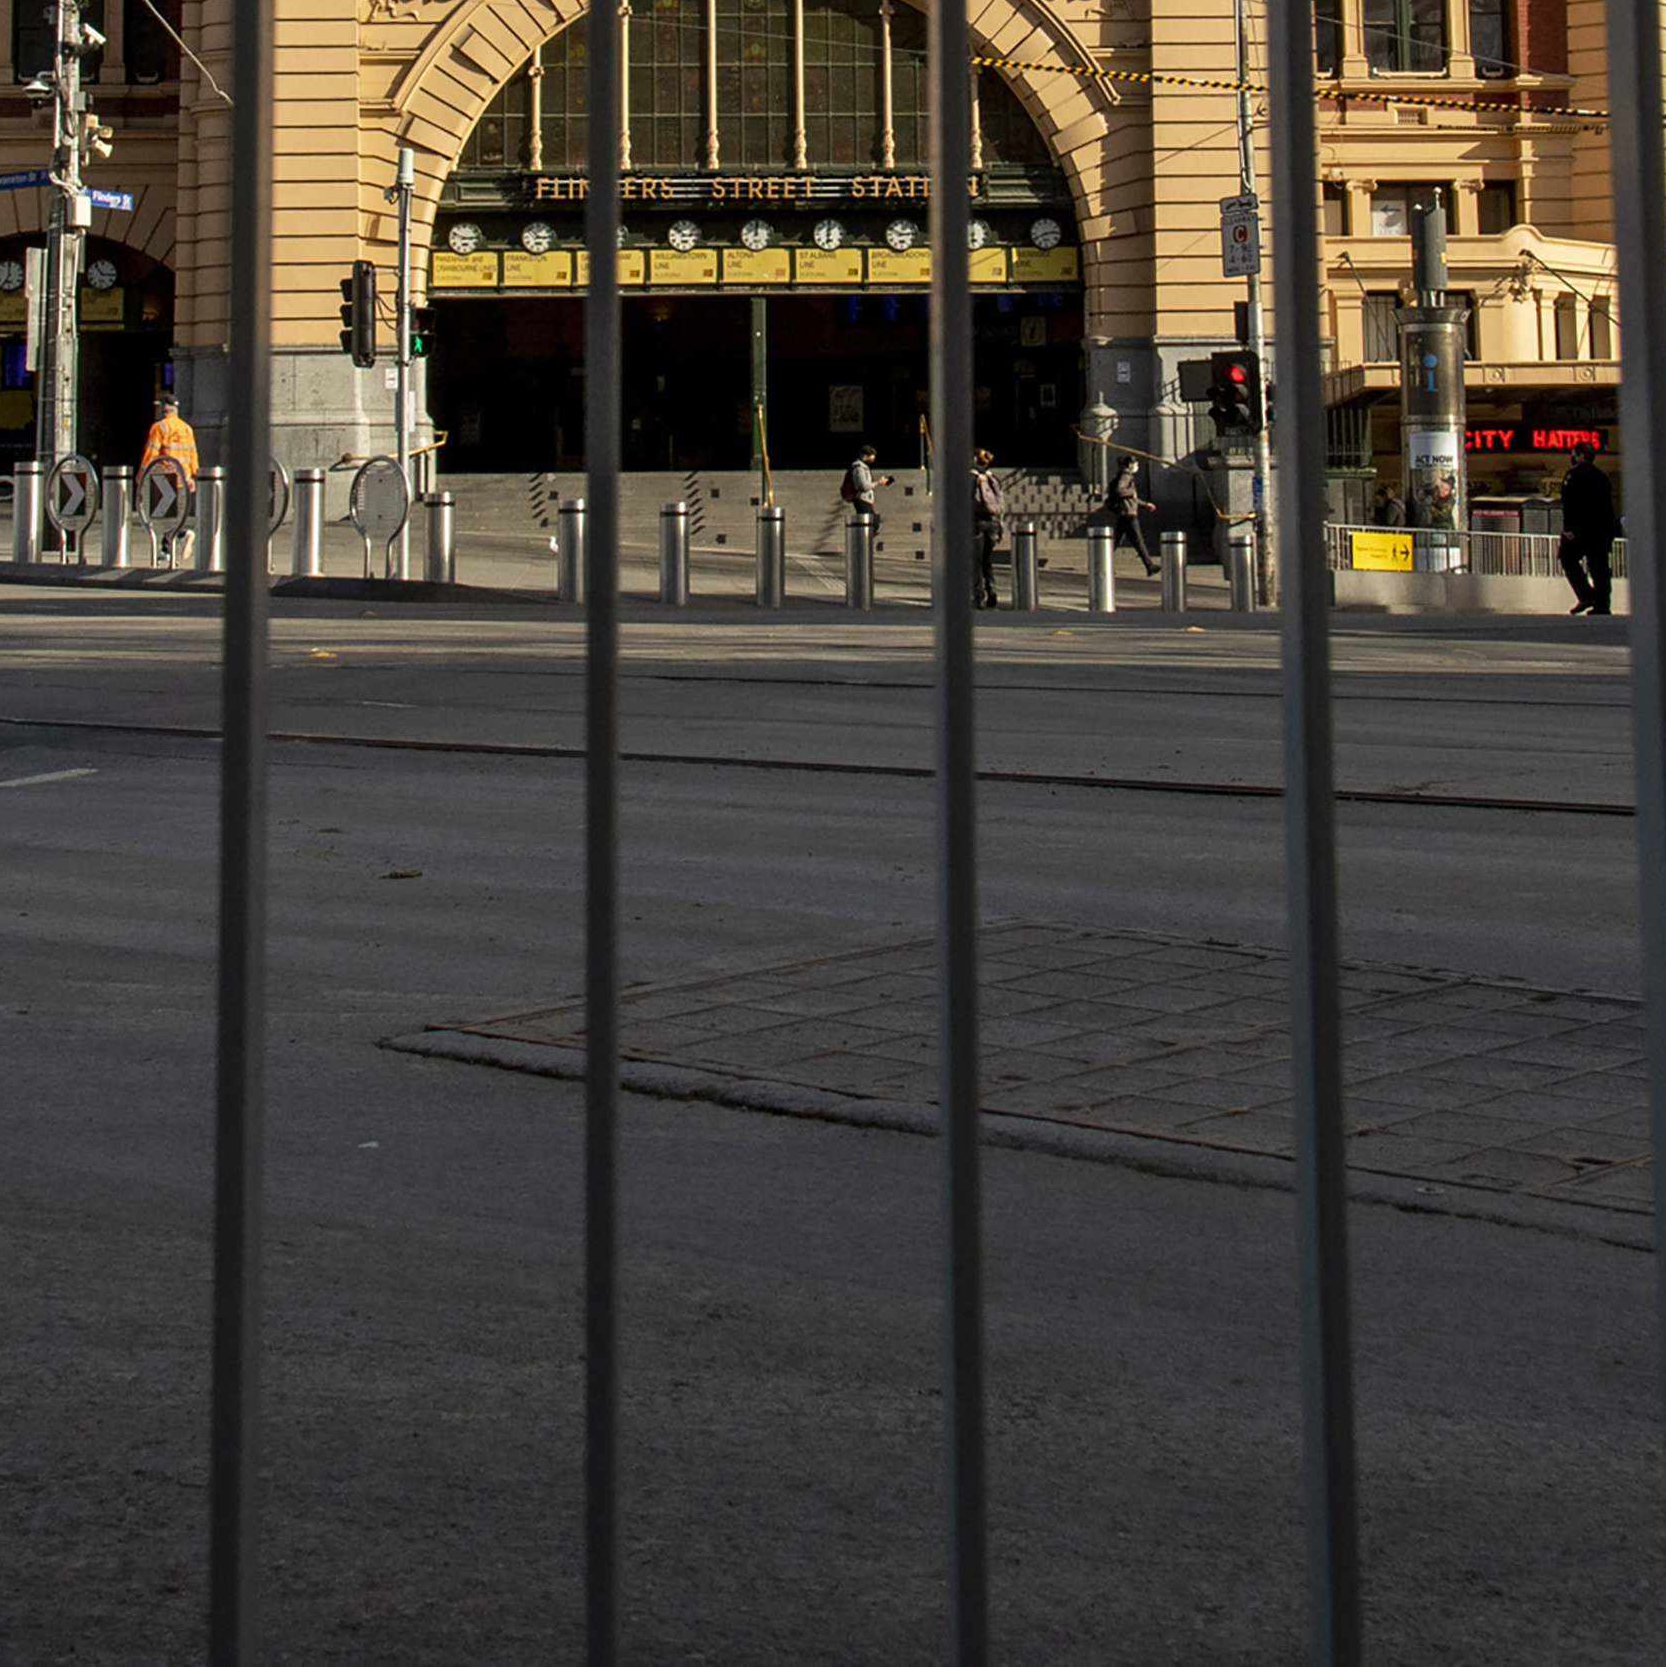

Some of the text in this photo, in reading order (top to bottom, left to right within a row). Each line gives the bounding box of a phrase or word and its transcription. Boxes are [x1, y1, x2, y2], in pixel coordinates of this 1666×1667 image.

[28, 172, 36, 182] St
[536, 175, 979, 200] FLINERS STREET STATIN
[92, 190, 120, 203] Flinders
[1235, 226, 1245, 242] C
[727, 251, 755, 260] ALTONA
[799, 251, 812, 260] ST
[654, 261, 670, 270] LINE
[727, 260, 742, 269] LINE
[799, 260, 815, 269] LINE
[872, 260, 887, 269] LINE
[1465, 429, 1514, 449] CITY
[1416, 454, 1454, 463] ACT NOW
